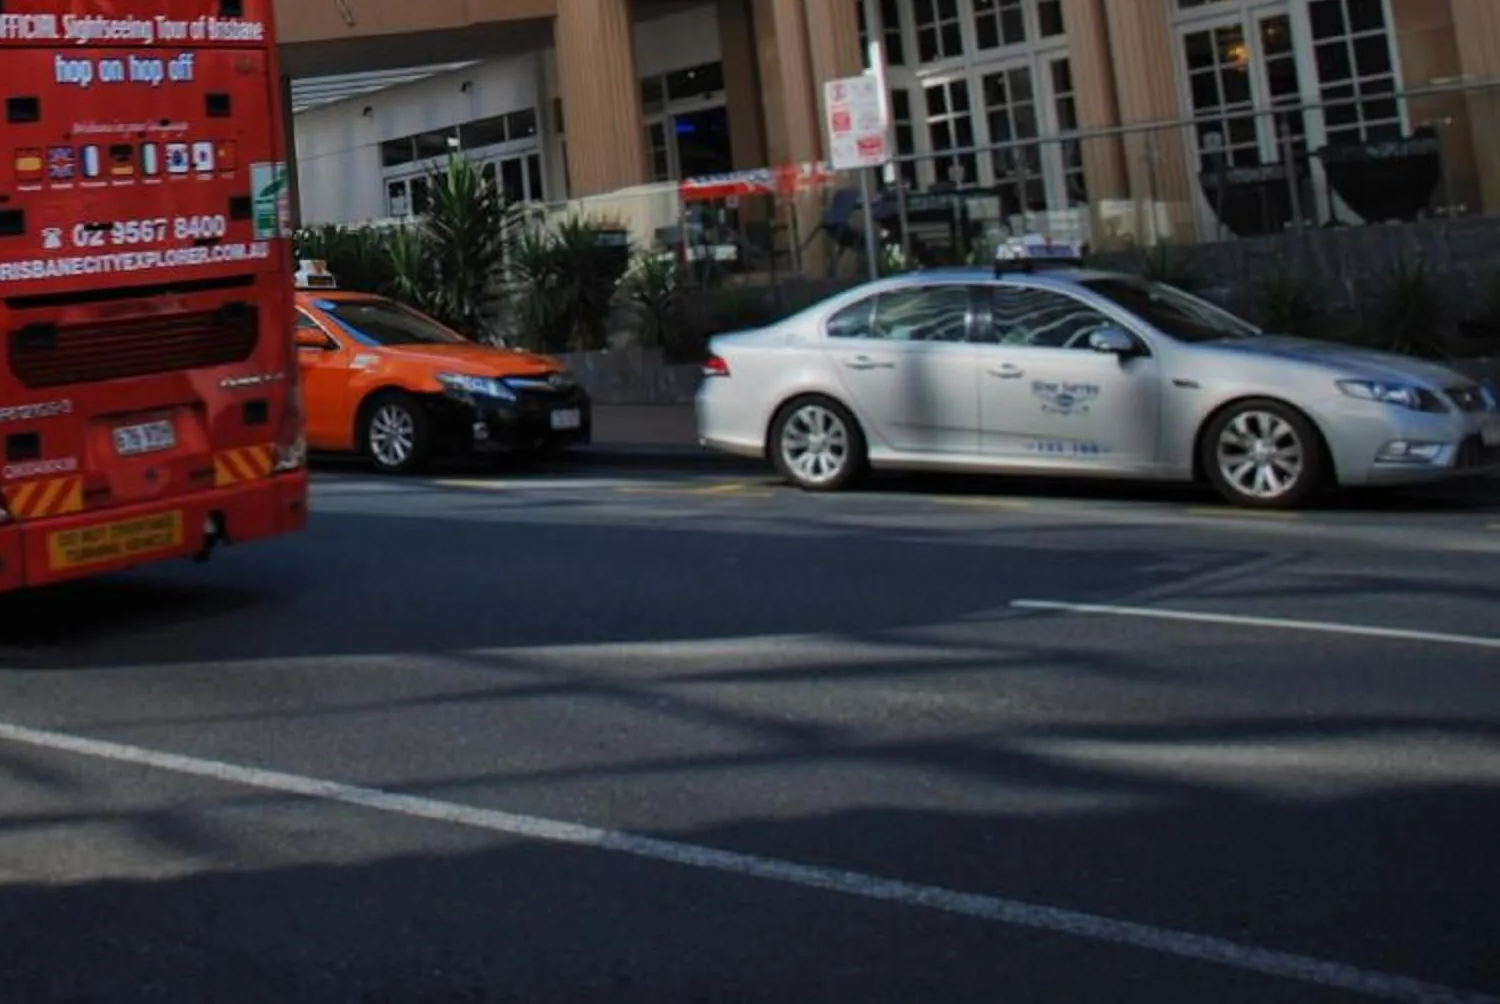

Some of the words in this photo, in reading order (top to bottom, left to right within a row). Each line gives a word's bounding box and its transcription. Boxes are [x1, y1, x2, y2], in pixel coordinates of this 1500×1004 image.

[63, 14, 153, 45] Sightseeing
[155, 15, 188, 41] Tour
[190, 15, 206, 40] of
[207, 15, 265, 41] Brisbane
[54, 52, 93, 87] hop
[98, 58, 125, 82] on
[129, 53, 164, 87] hop
[167, 53, 195, 81] off
[110, 218, 168, 245] 9567
[173, 214, 226, 239] 8400
